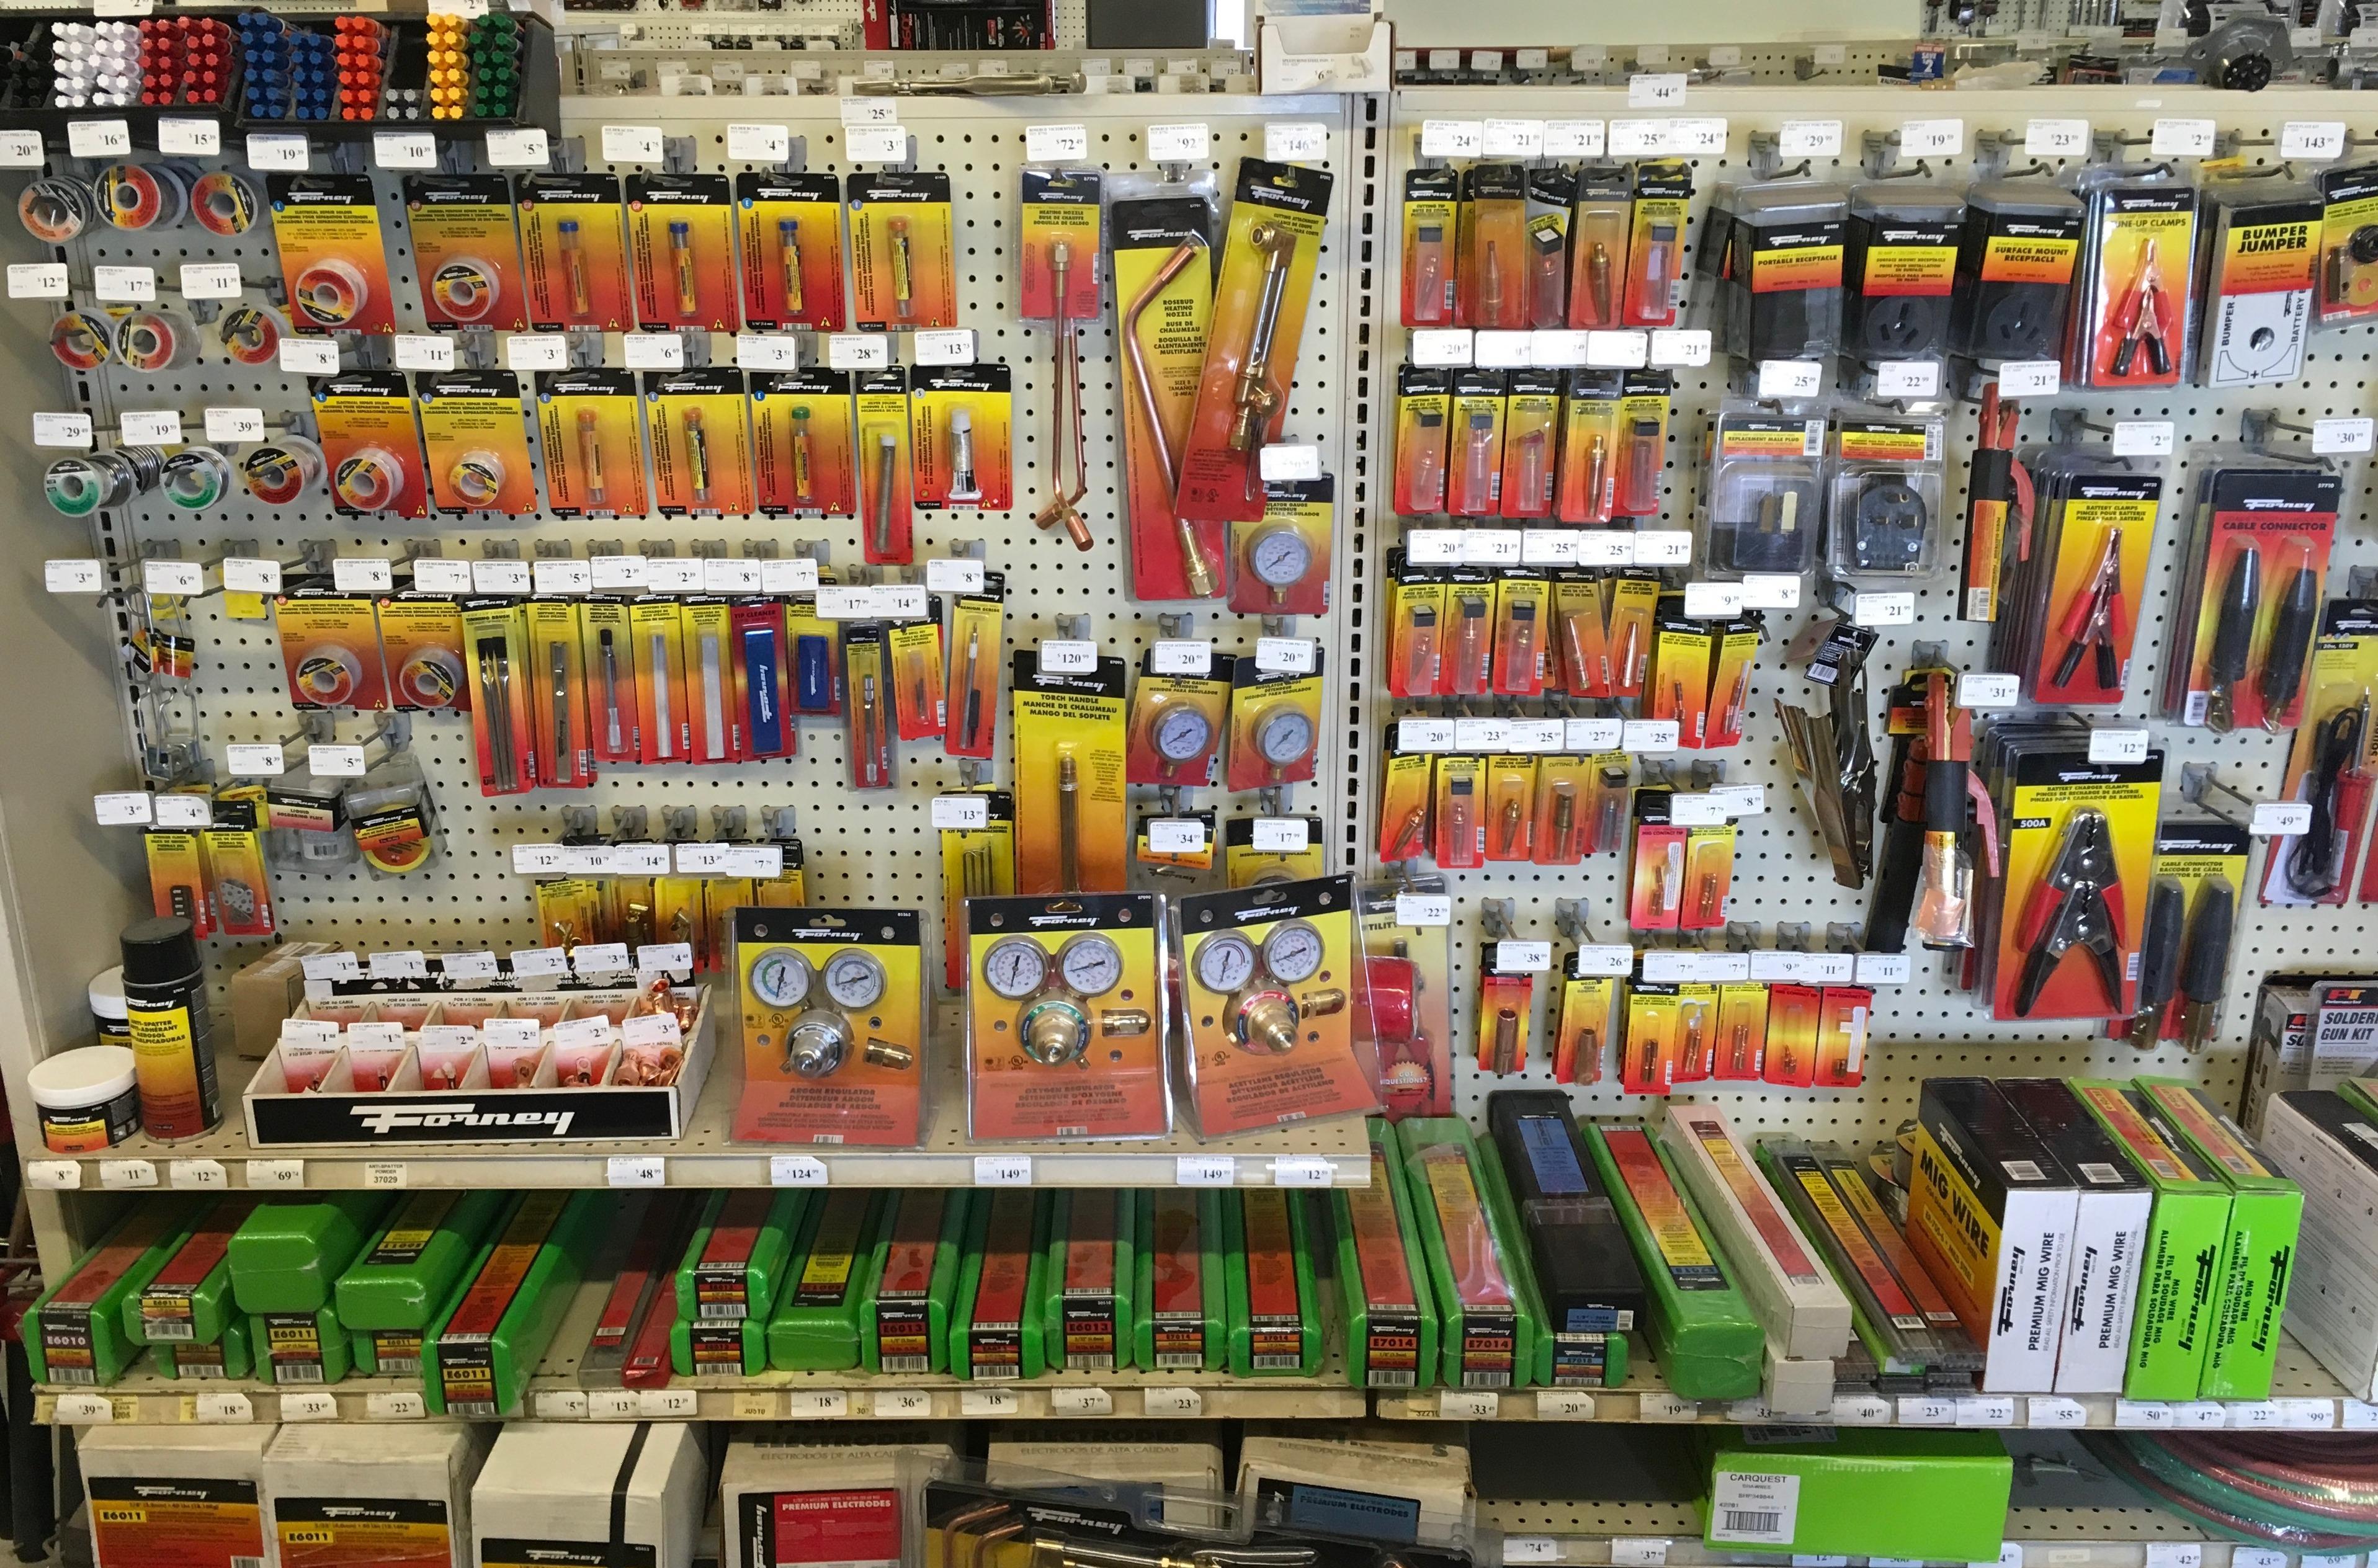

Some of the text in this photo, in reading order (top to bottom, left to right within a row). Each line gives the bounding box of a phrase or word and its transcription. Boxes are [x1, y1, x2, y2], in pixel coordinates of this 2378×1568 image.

[1251, 186, 1312, 209] Forney
[2122, 199, 2178, 210] Forney
[1883, 231, 1945, 243] Forney
[2007, 225, 2064, 237] Forney
[2243, 225, 2307, 239] BUMPER
[1769, 234, 1828, 246] Forney
[2237, 237, 2307, 253] JUMPER
[1795, 254, 1837, 264] RECEPTACLE
[2222, 302, 2235, 346] BUMPER
[2292, 296, 2305, 342] BATTERY
[2081, 486, 2145, 499] Forney
[2243, 499, 2315, 512] Forney
[2260, 523, 2327, 531] CONNECTOR
[735, 610, 744, 618] TIP
[1070, 704, 1117, 713] CHALUMEAU
[2058, 772, 2117, 782] Forney
[2020, 819, 2046, 827] 500A
[2160, 840, 2234, 852] Forney
[1235, 906, 1297, 920] Forney
[1029, 915, 1098, 926] Forney
[792, 929, 860, 940] Forney
[2321, 1028, 2374, 1040] GUN KIT
[349, 1103, 575, 1135] Forney
[373, 1176, 398, 1184] 37029
[1920, 1148, 1990, 1259] MIG WIRE
[1997, 1246, 2026, 1335] Forney
[2028, 1232, 2055, 1351] PREMIUM MIG WIRE
[2071, 1246, 2098, 1335] Forney
[2099, 1231, 2127, 1349] PREMIUM MIG WIRE
[2139, 1230, 2169, 1368] ALAMBRE PARA SOLDADURA MIG
[2153, 1255, 2175, 1343] FIL DE SOUDAGE MIG
[2166, 1279, 2180, 1321] MIG WIRE
[2178, 1244, 2216, 1352] Forney
[2251, 1245, 2290, 1352] Forney
[883, 1324, 923, 1332] E6013
[1070, 1322, 1109, 1332] E6013
[47, 1335, 86, 1345] E6010
[273, 1329, 312, 1340] E6011
[1373, 1339, 1414, 1348] E7014
[1468, 1340, 1509, 1349] E7014
[447, 1370, 486, 1379] E6011
[761, 1450, 870, 1461] ELECTRODOS DE ALTA
[1106, 1446, 1132, 1454] ALTA
[1133, 1446, 1179, 1454] CALIDAD
[1730, 1474, 1787, 1483] CARQUEST
[833, 1500, 891, 1508] ELECTRODES
[1300, 1495, 1408, 1518] PREMIUM ELECTRODES
[103, 1511, 142, 1521] E6011
[1027, 1507, 1122, 1535] Forney
[288, 1532, 329, 1542] E6011
